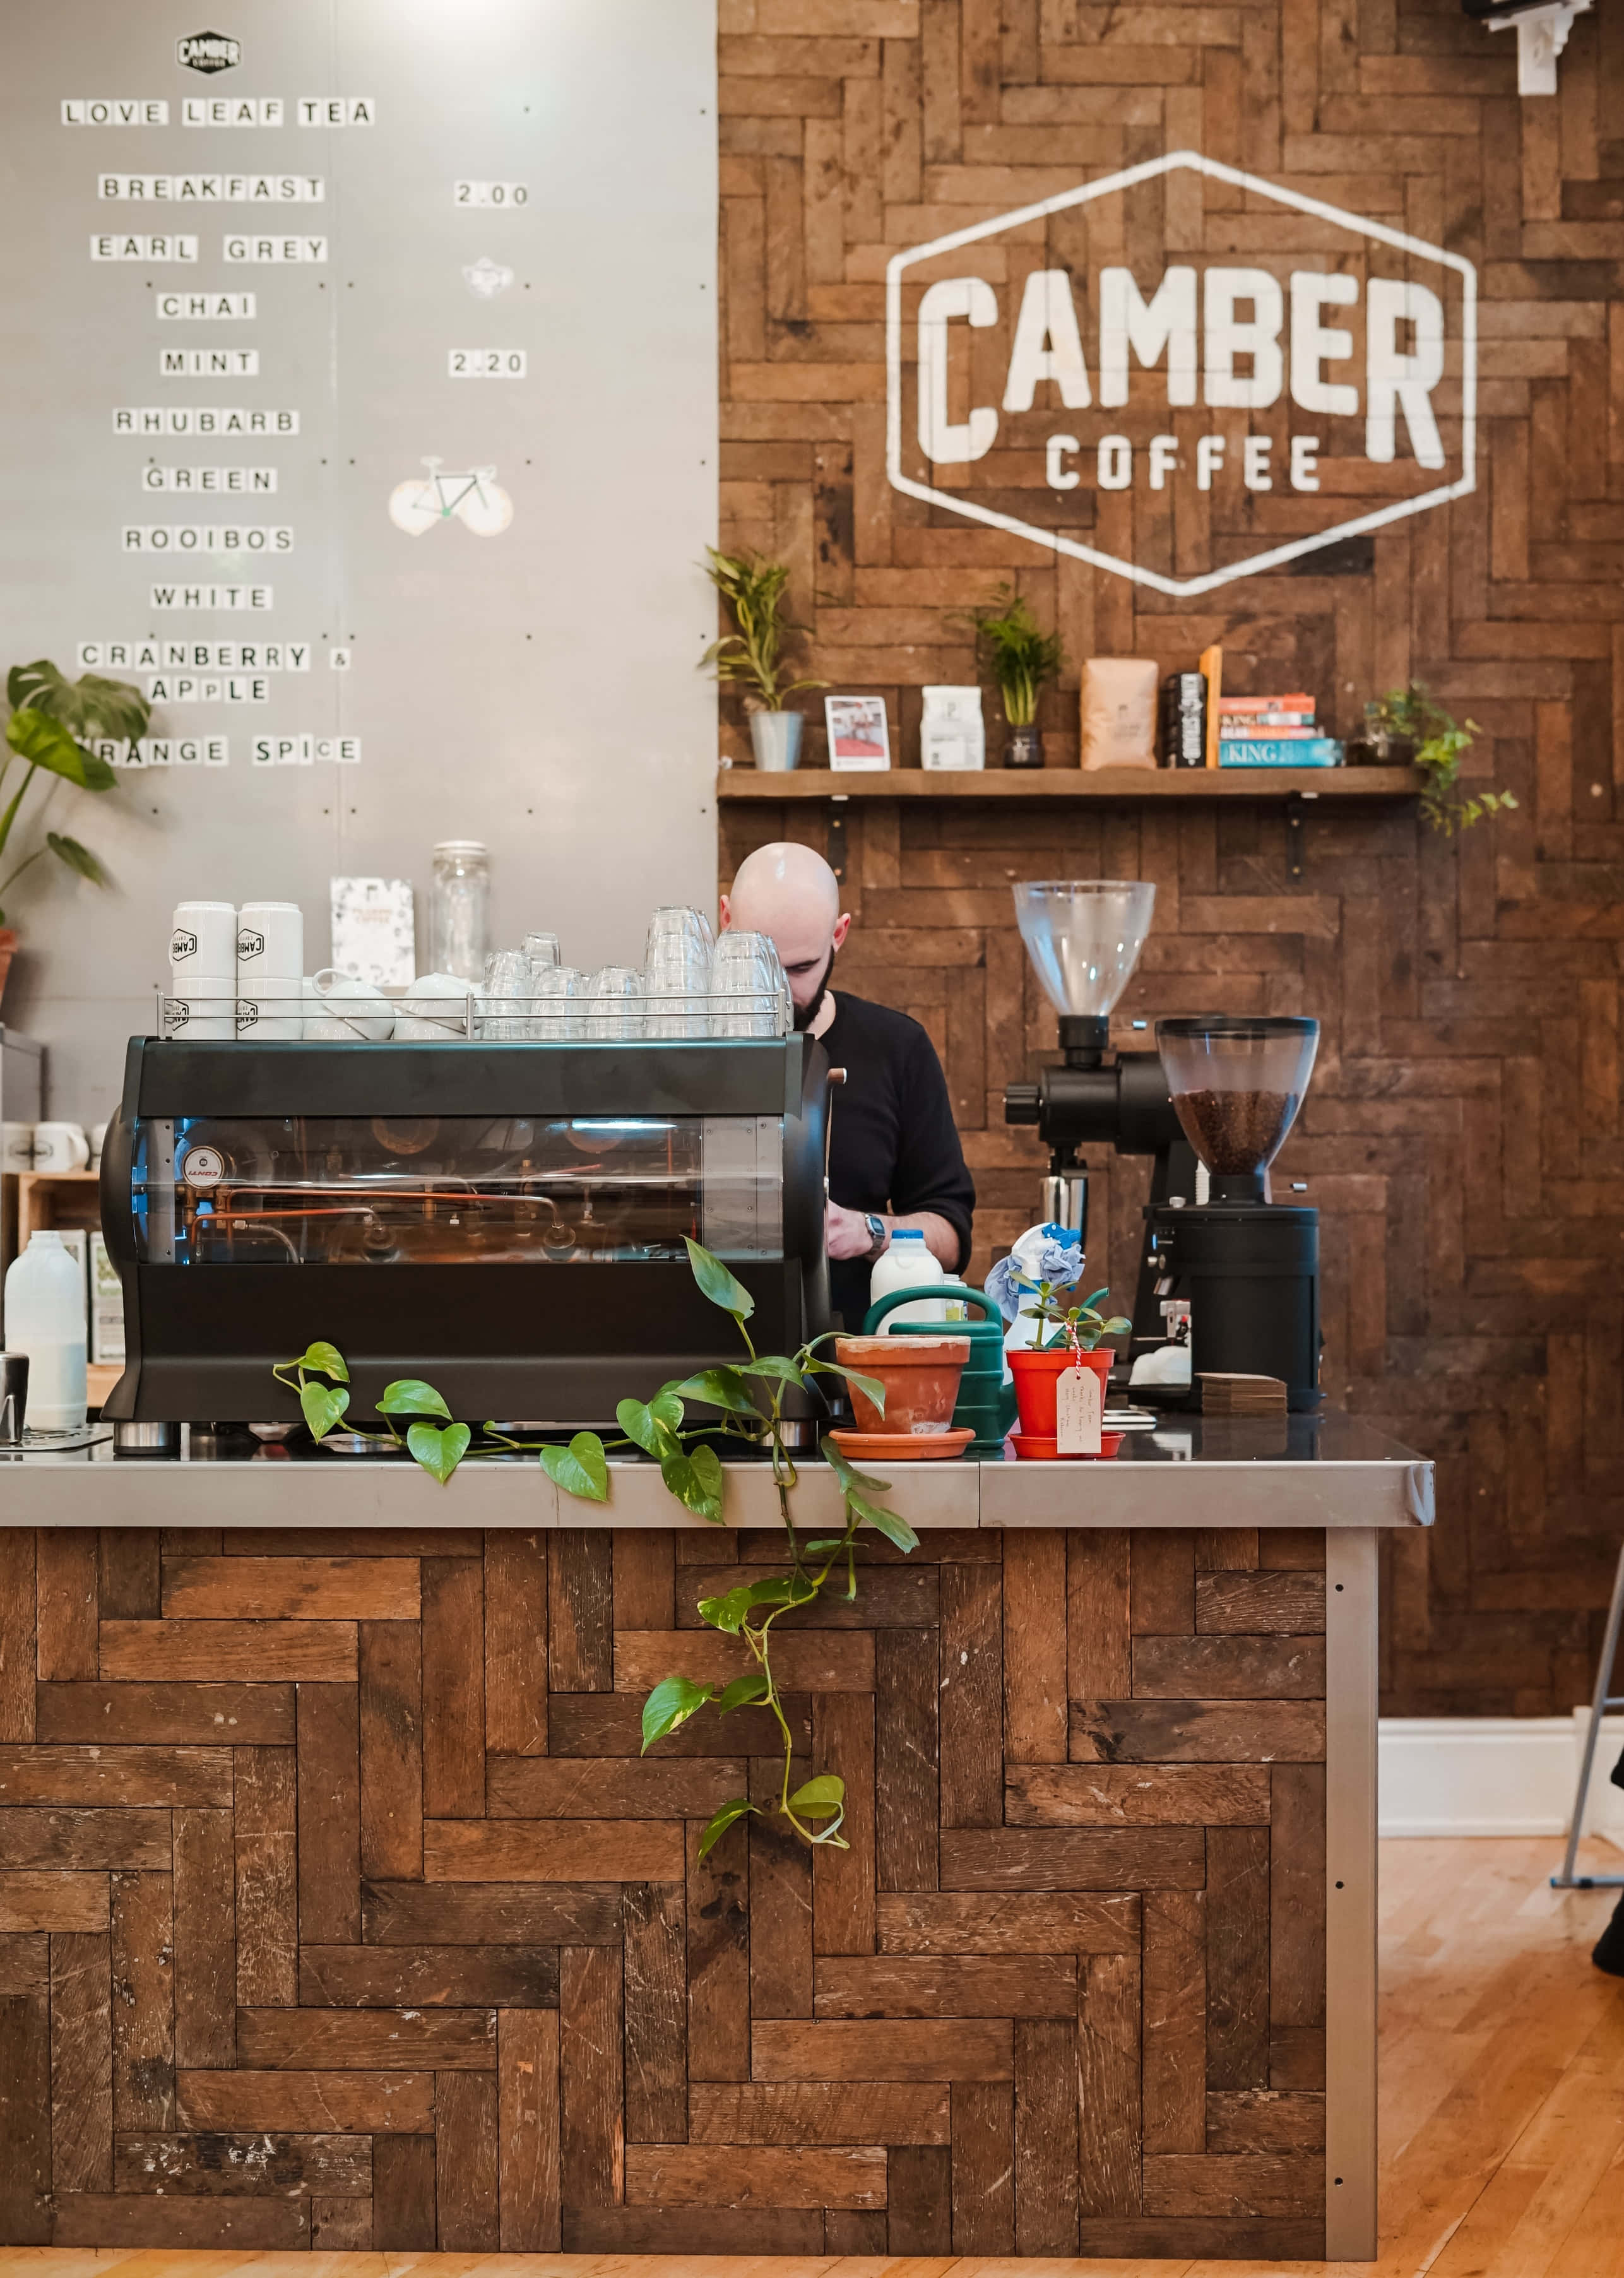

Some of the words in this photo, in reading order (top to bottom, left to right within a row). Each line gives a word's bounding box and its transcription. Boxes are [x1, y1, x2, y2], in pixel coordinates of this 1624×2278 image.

[178, 39, 239, 64] CAMBER
[66, 104, 161, 123] LOVE
[187, 103, 279, 122] LEAF
[304, 103, 369, 122] TEA
[104, 179, 321, 199] BREAKFAST
[459, 184, 528, 205] 2.00
[98, 237, 192, 259] EARL
[228, 240, 323, 259] GREY
[163, 297, 248, 316] CHAI
[165, 353, 250, 372] MINT
[454, 353, 522, 372] 2.20
[917, 265, 1445, 469] CAMBER
[116, 412, 293, 432] RHUBARB
[1045, 434, 1321, 491] COFFEE
[146, 470, 270, 490] GREEN
[126, 530, 291, 550] ROOIBOS
[153, 588, 266, 608] WHITE
[82, 646, 305, 667] CRANBERRY
[335, 653, 348, 666] &
[84, 740, 223, 764] RANGE
[1229, 744, 1277, 762] KING
